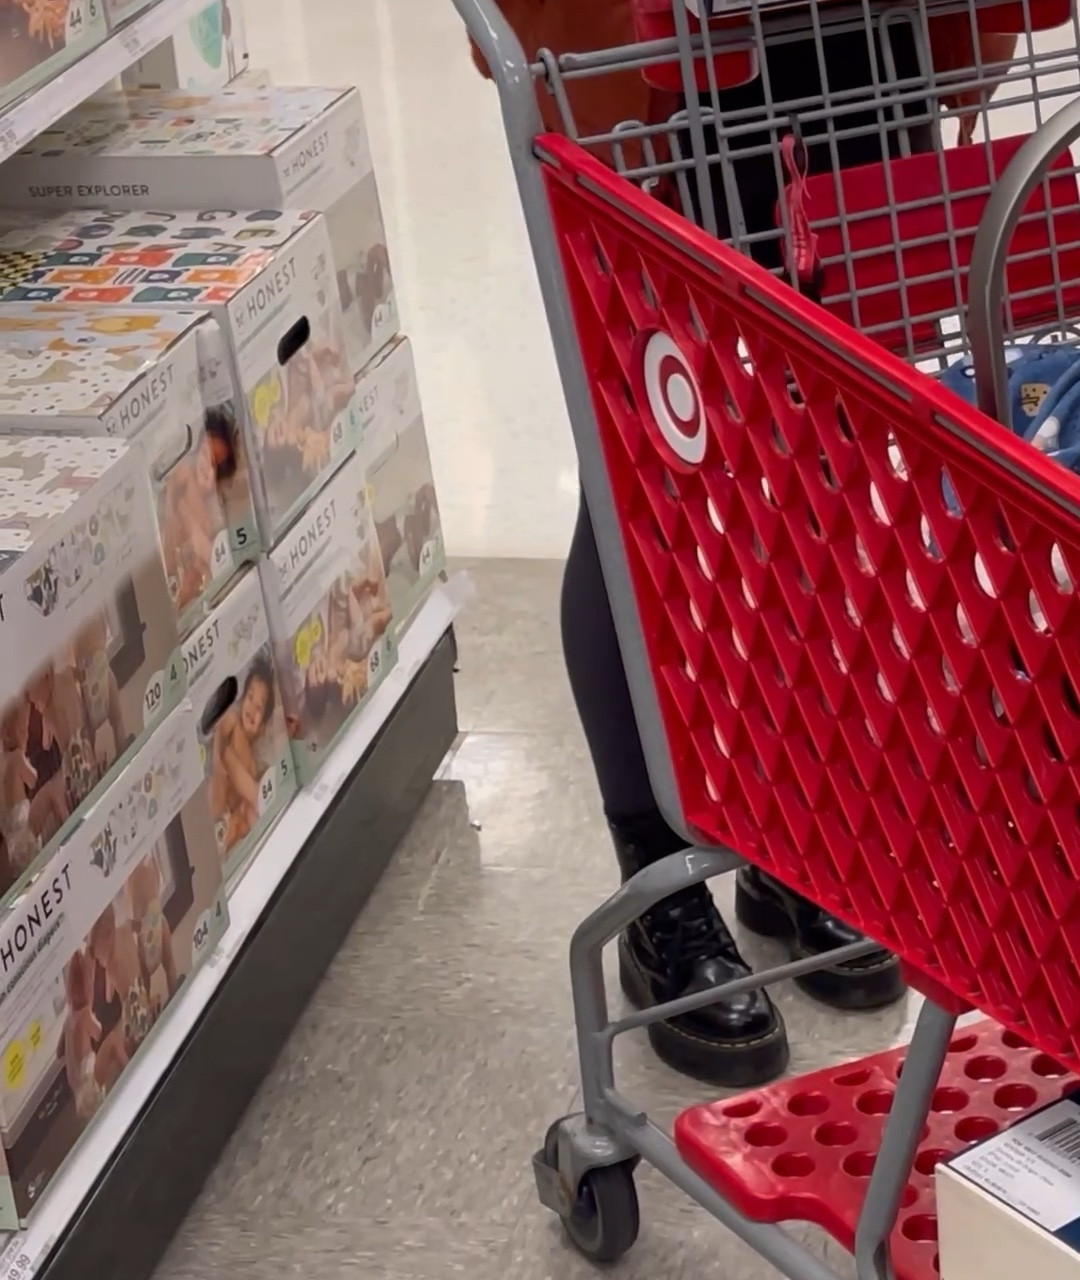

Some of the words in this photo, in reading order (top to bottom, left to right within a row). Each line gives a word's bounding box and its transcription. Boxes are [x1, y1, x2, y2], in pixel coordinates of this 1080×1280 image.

[69, 6, 84, 29] 44
[290, 130, 331, 174] HONEST
[28, 184, 74, 199] SUPER
[76, 183, 151, 198] EXPLORER
[246, 256, 297, 320] HONEST
[119, 363, 174, 430] HONEST
[236, 527, 248, 546] 5
[288, 498, 338, 570] HONEST
[184, 620, 221, 674] NEST
[169, 663, 178, 683] 4
[145, 681, 162, 711] 120
[281, 759, 288, 777] 5
[0, 862, 72, 972] HONEST
